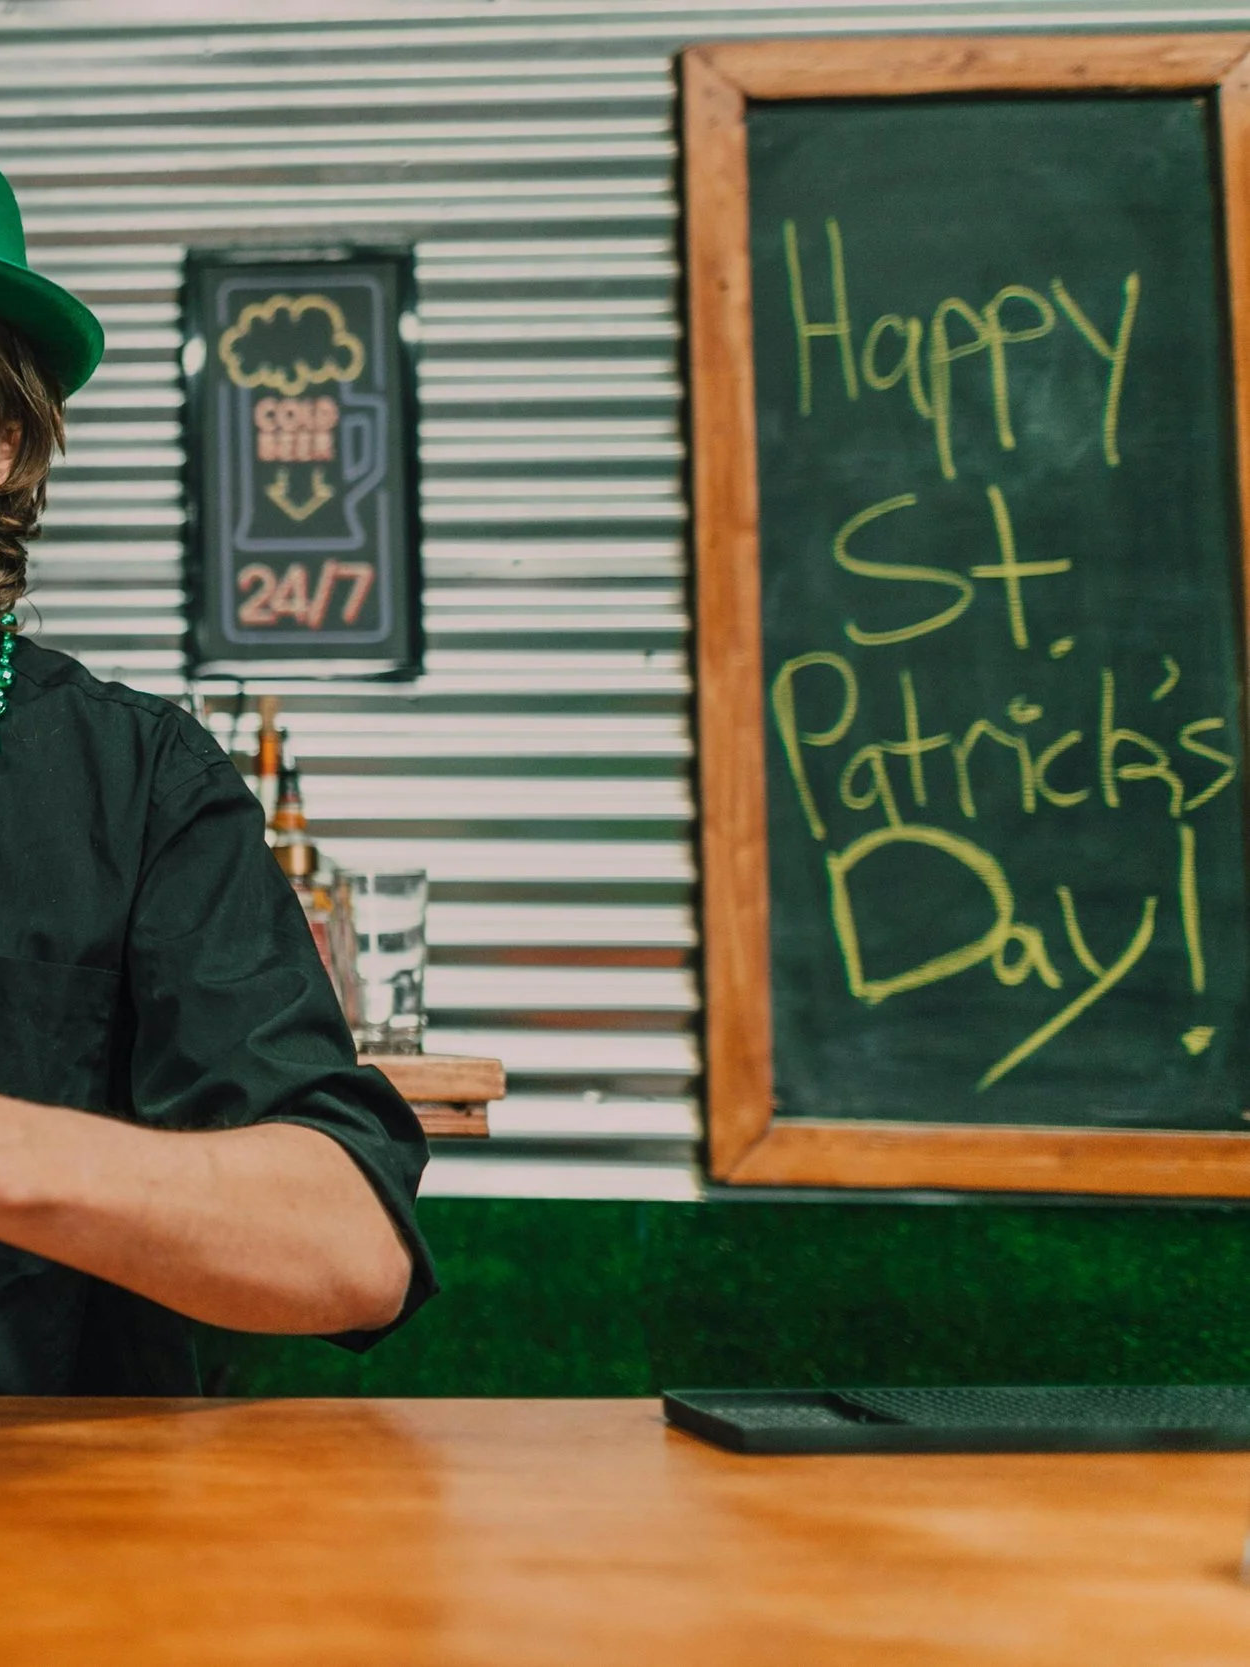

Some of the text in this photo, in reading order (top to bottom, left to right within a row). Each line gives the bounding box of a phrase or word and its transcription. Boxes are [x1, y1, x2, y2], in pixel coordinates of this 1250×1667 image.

[254, 396, 339, 432] COLD
[782, 217, 1140, 480] Happy
[238, 560, 375, 630] 24/7
[833, 485, 1075, 658] St.
[772, 651, 1237, 842] Patrick's
[827, 824, 1216, 1091] Day!
